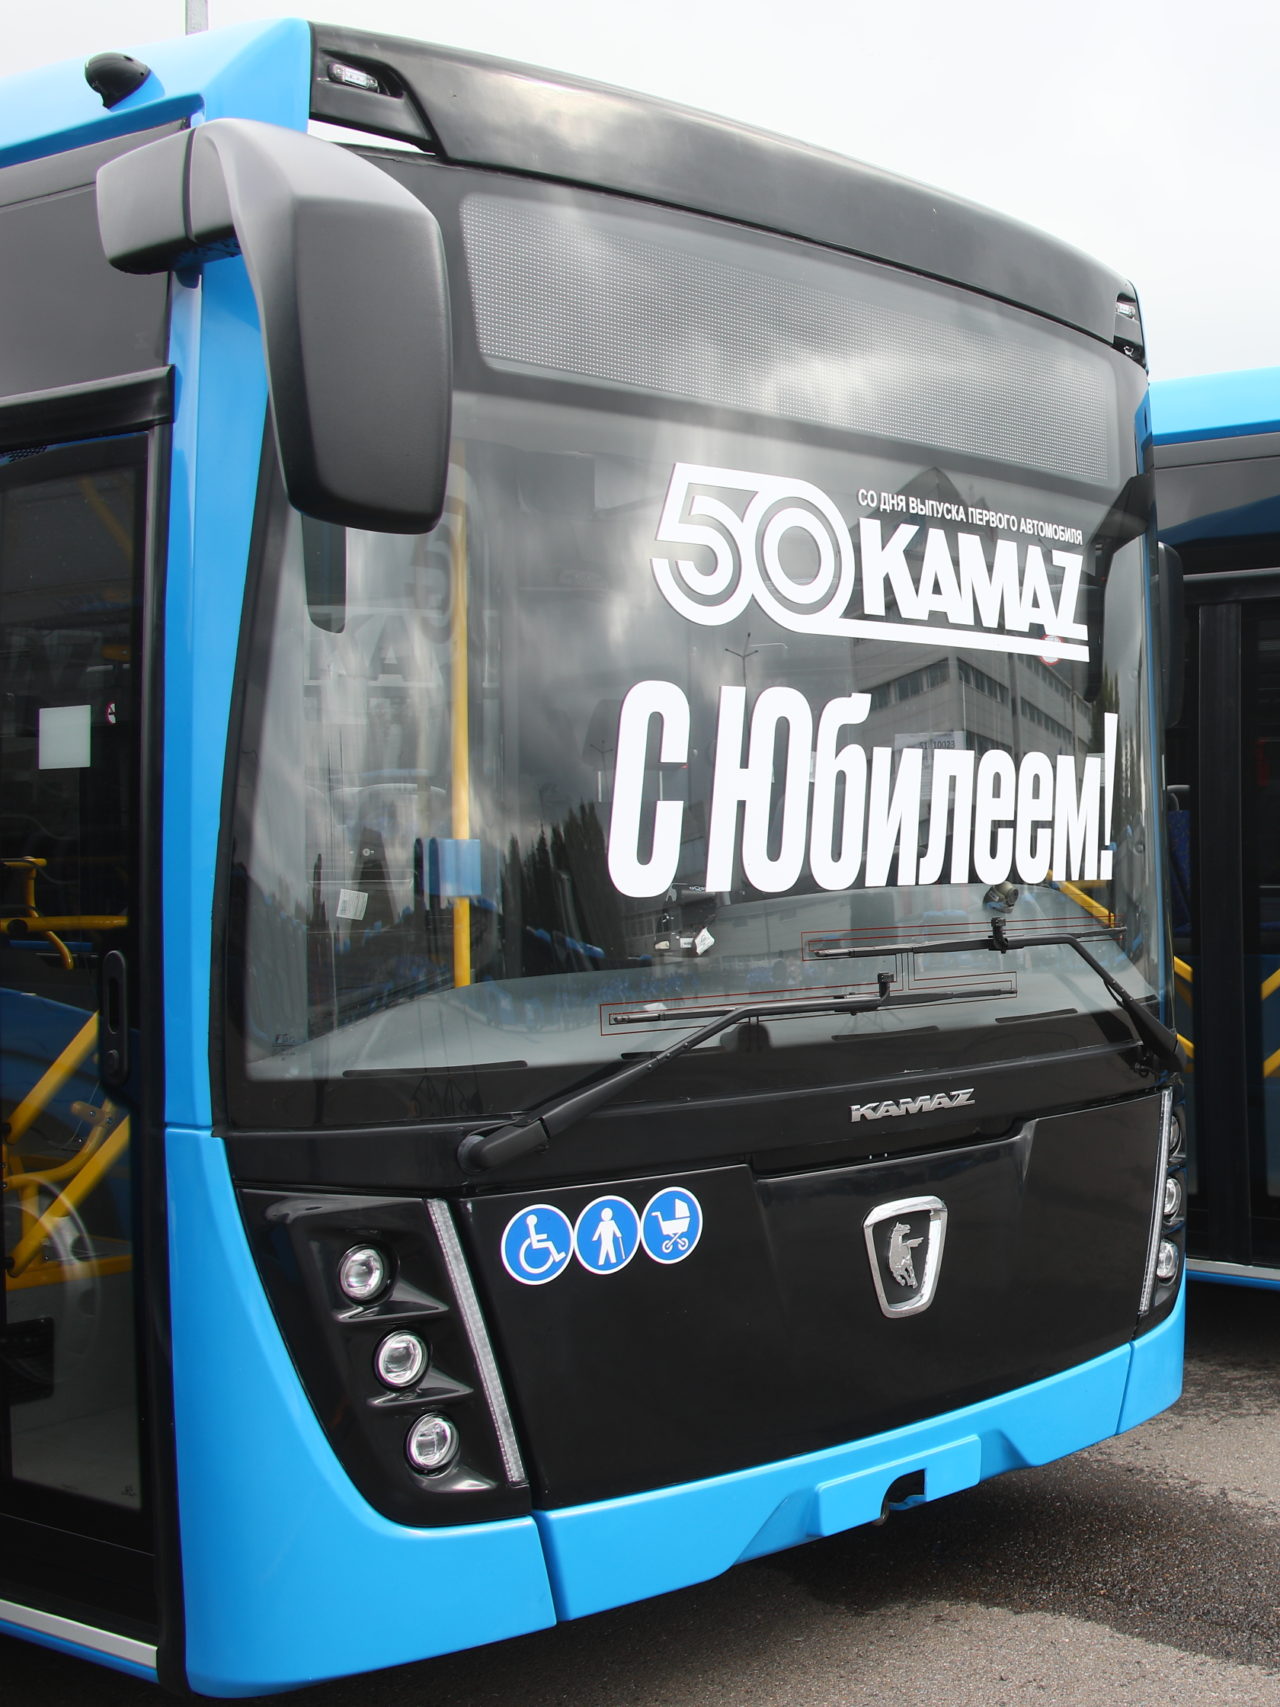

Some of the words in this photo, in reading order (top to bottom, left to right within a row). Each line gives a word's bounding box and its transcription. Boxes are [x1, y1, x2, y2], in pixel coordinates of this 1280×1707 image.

[651, 462, 855, 631] 50
[858, 488, 877, 507] СО
[880, 492, 906, 513] ДНЯ
[909, 496, 966, 523] ВЫПУСКА
[968, 507, 1018, 532] ПЕРВОГО
[1020, 518, 1083, 545] АВТОМОБИЛЯ
[859, 517, 1088, 641] KAMAZ
[607, 680, 691, 898] С
[705, 686, 1119, 893] Юбилеем!
[850, 1087, 976, 1123] KAMAZ
